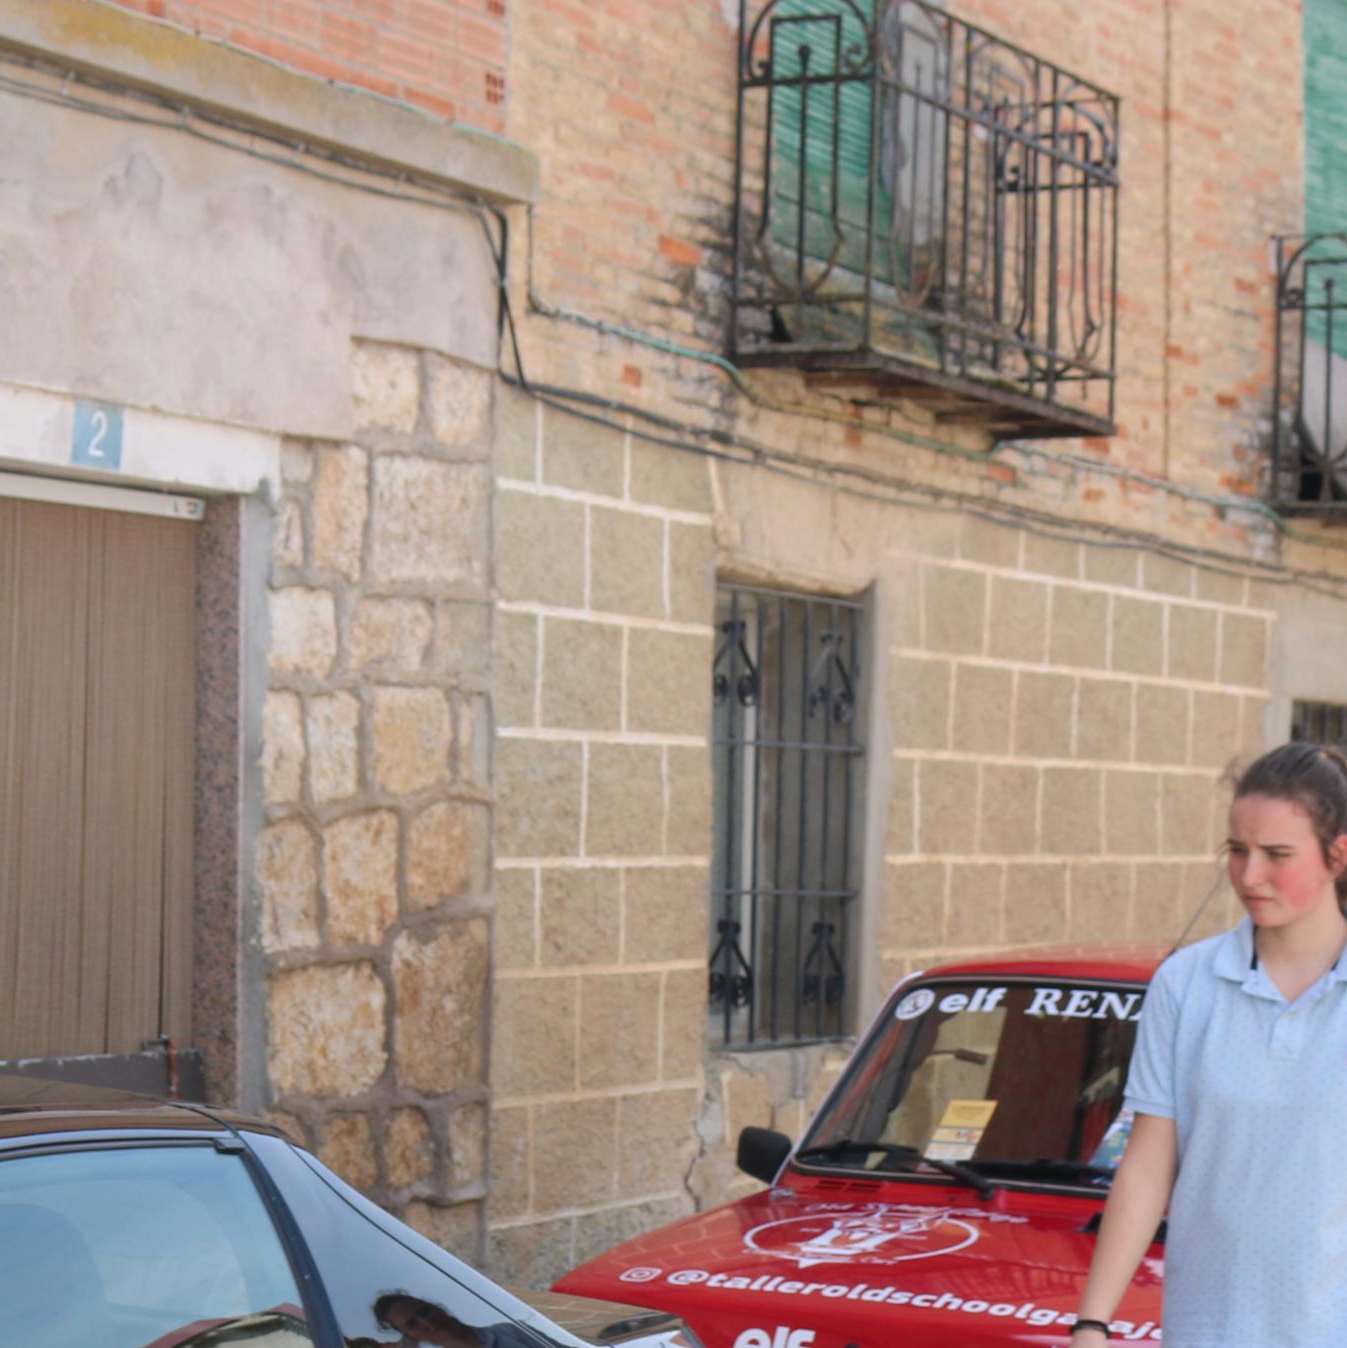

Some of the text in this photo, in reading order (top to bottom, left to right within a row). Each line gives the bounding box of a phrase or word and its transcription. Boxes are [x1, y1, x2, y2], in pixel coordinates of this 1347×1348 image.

[89, 410, 108, 457] 2
[939, 988, 1008, 1013] elf
[666, 1269, 1163, 1340] @talleroldschoolgaaj
